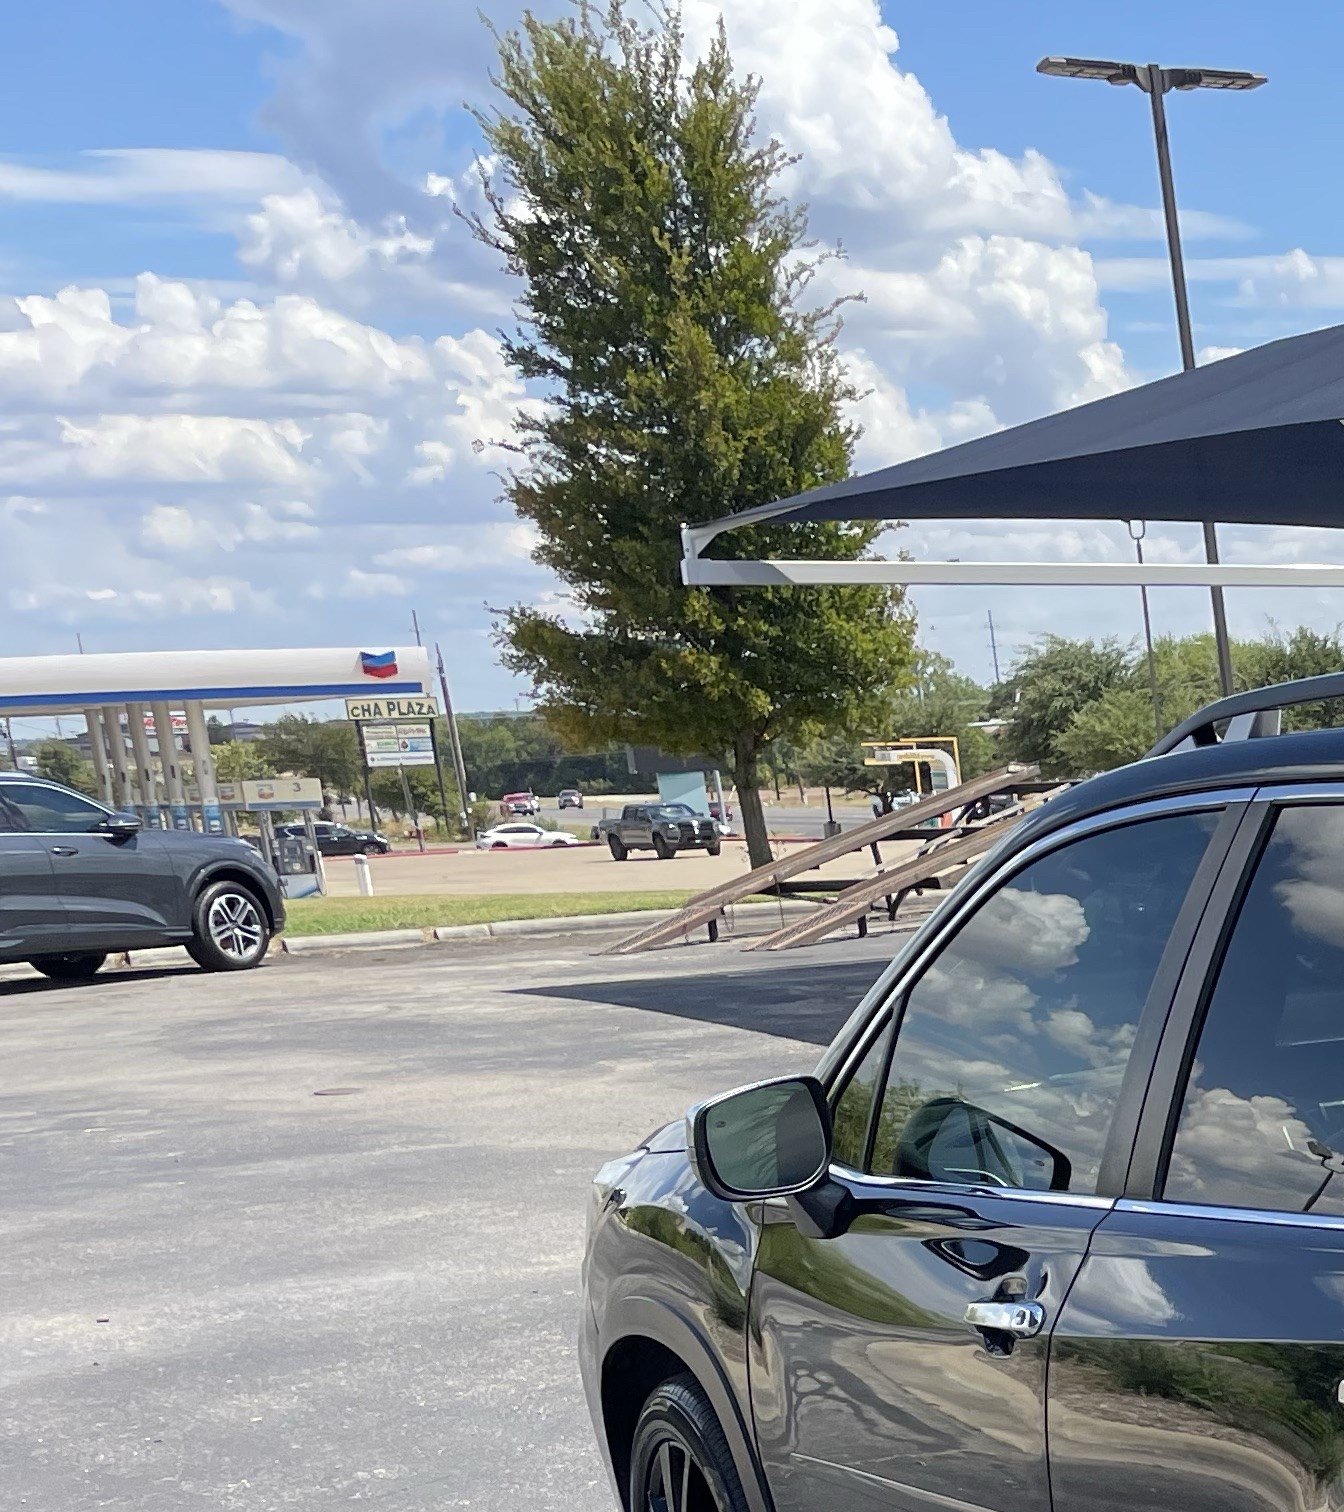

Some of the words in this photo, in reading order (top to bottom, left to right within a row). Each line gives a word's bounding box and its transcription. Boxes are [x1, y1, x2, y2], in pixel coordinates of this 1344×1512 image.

[351, 703, 382, 717] CHA
[387, 701, 436, 716] PLAZA
[293, 782, 301, 792] 3
